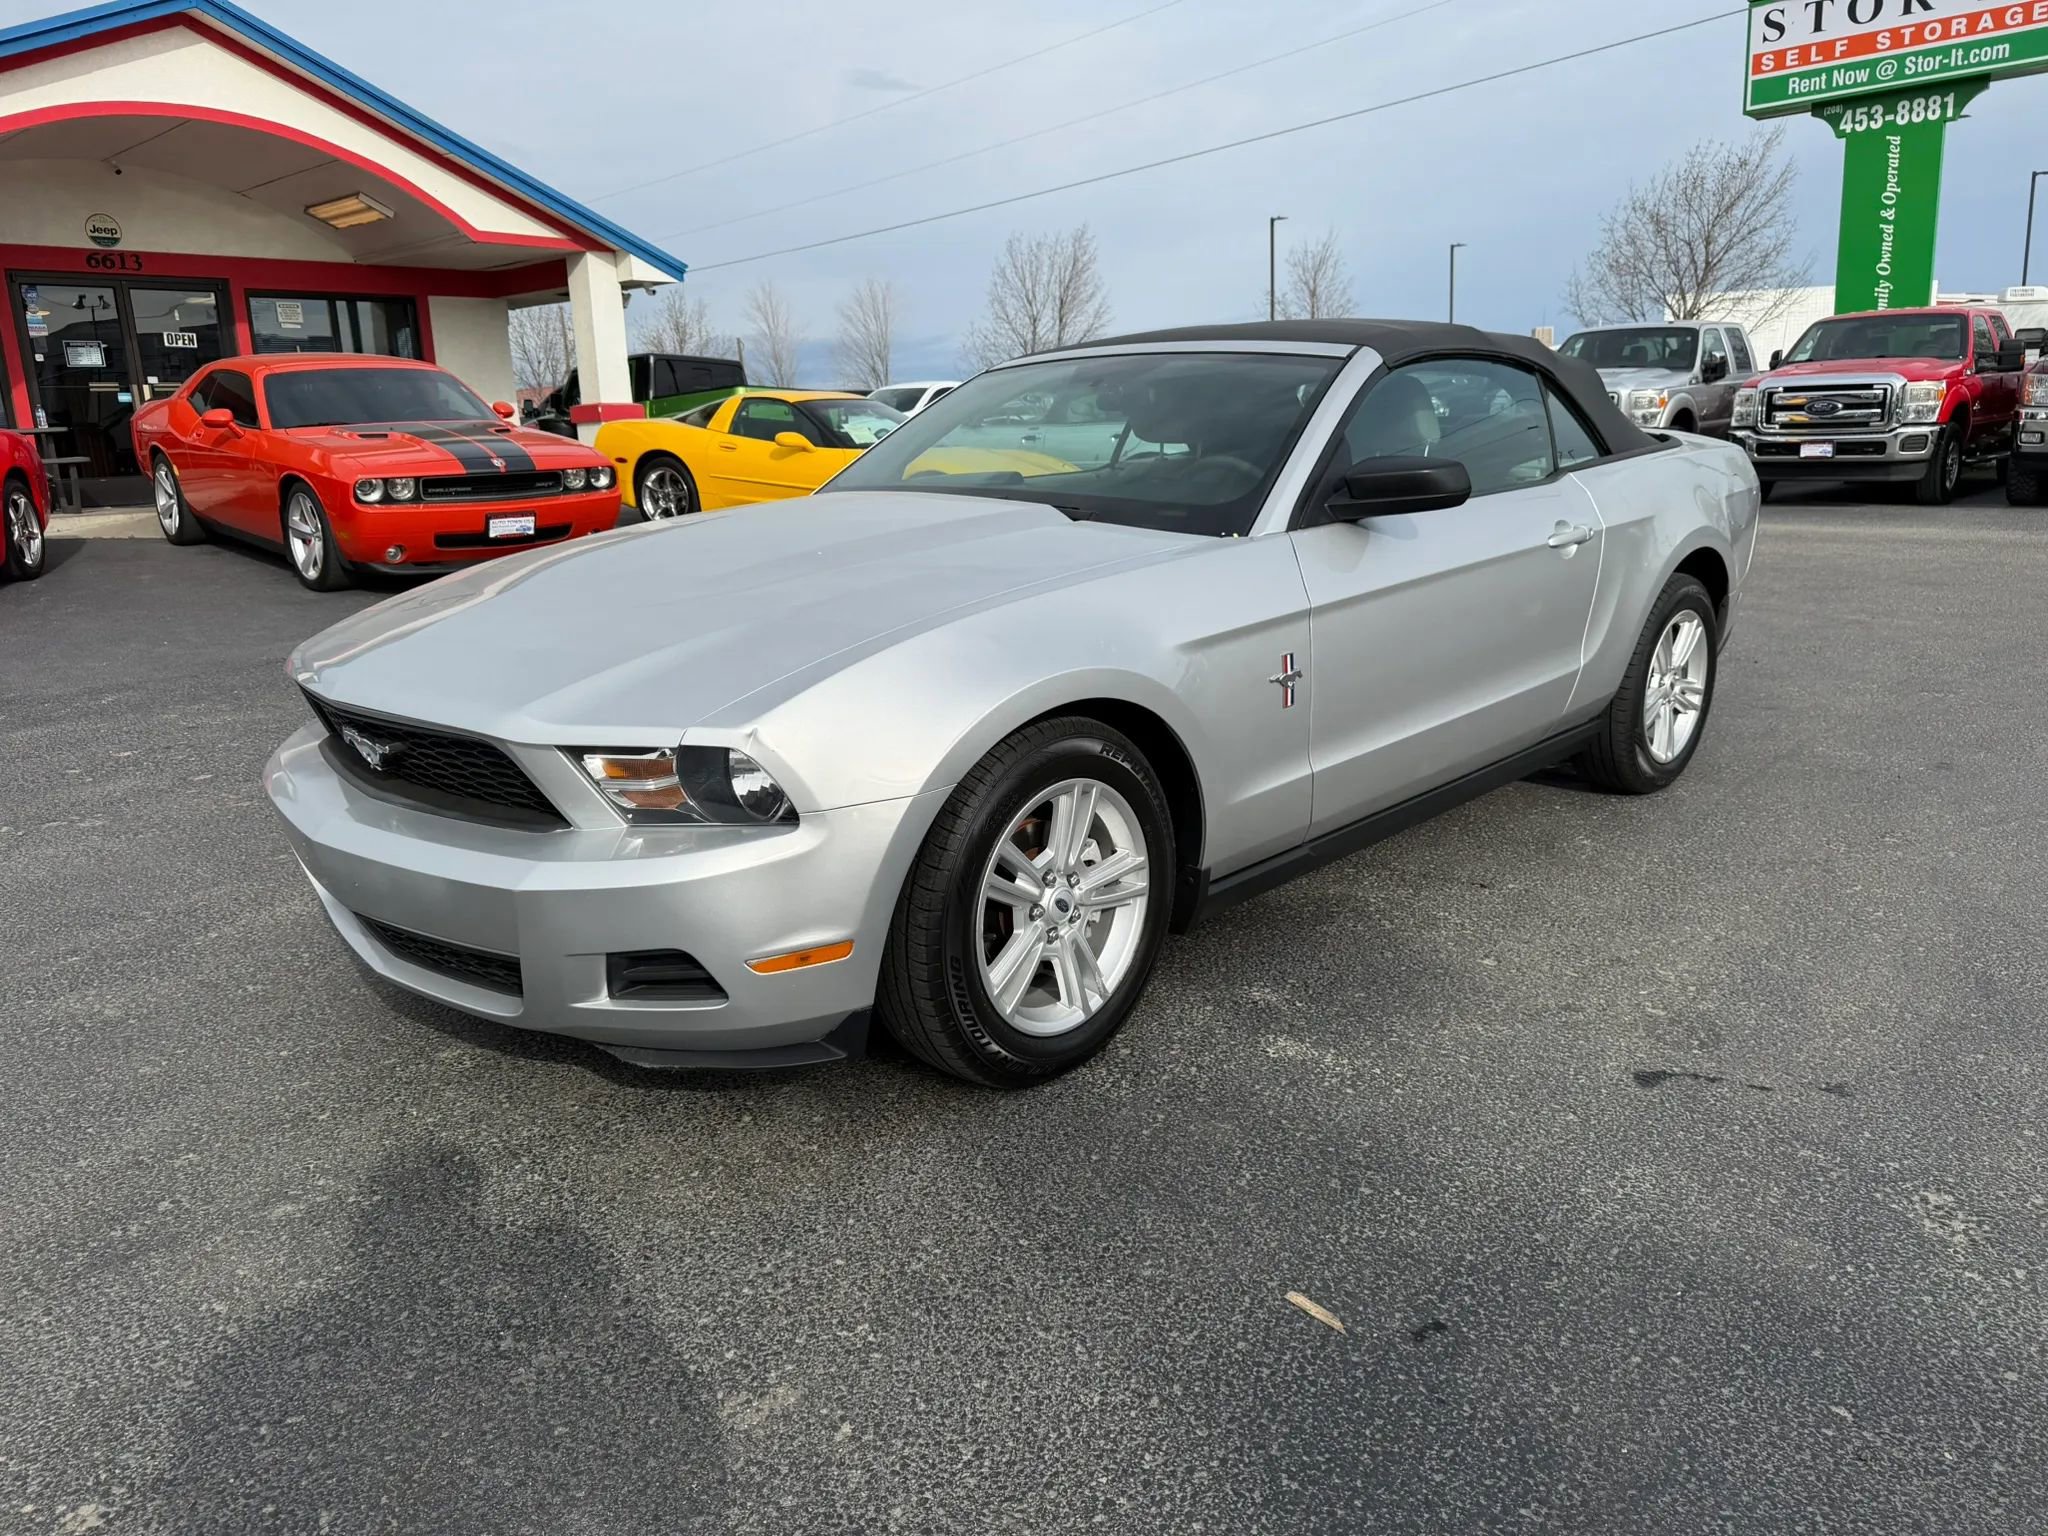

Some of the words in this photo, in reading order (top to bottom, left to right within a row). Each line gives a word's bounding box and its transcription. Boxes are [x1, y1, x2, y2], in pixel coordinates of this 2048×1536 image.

[1760, 39, 1849, 72] SELF
[1876, 2, 2048, 50] STORAGE
[1788, 72, 1827, 95] Rent
[1832, 68, 1870, 87] Now
[1876, 59, 1897, 80] @
[1904, 43, 2010, 75] Stor-It.com
[1839, 92, 1955, 134] 453-8881
[1881, 135, 1901, 205] Operated
[89, 224, 118, 236] Jeep
[1880, 207, 1895, 220] &
[86, 252, 143, 272] 6613
[1875, 224, 1894, 276] Owned
[1874, 280, 1893, 311] mily
[166, 333, 196, 346] OPEN
[950, 955, 993, 1049] TOURING
